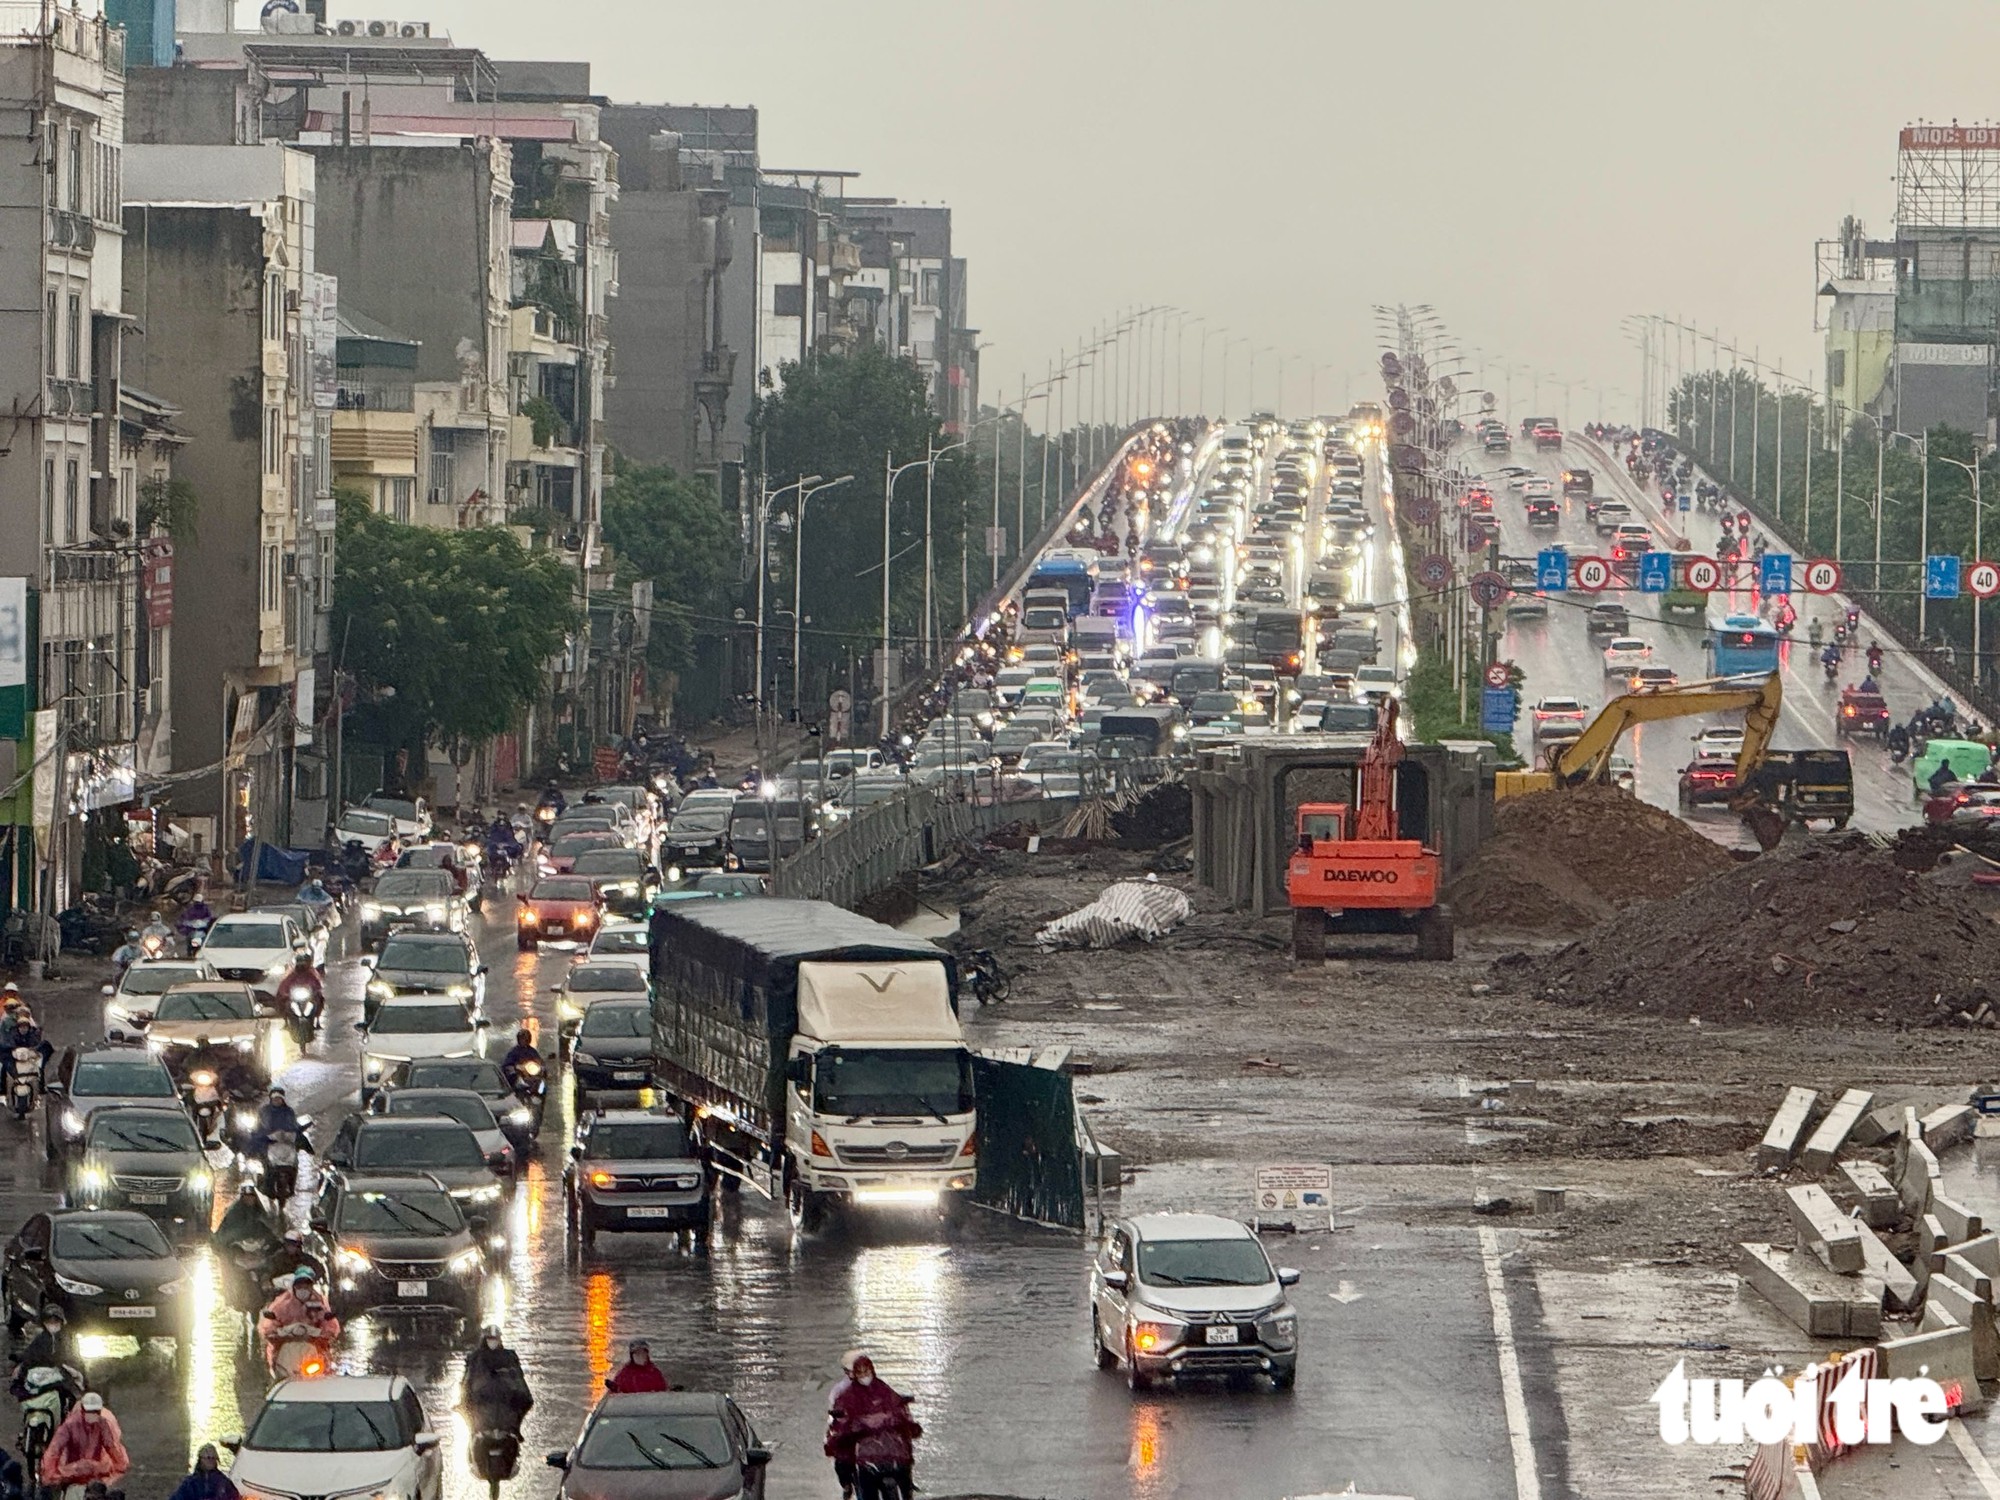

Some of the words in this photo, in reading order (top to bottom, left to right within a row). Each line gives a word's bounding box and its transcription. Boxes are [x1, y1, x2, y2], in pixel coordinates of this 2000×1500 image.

[1966, 129, 2000, 144] 091
[1585, 567, 1600, 582] 60
[1695, 568, 1710, 583] 60
[1815, 569, 1830, 584] 60
[1976, 572, 1992, 588] 40
[1323, 869, 1398, 884] DAEWOO
